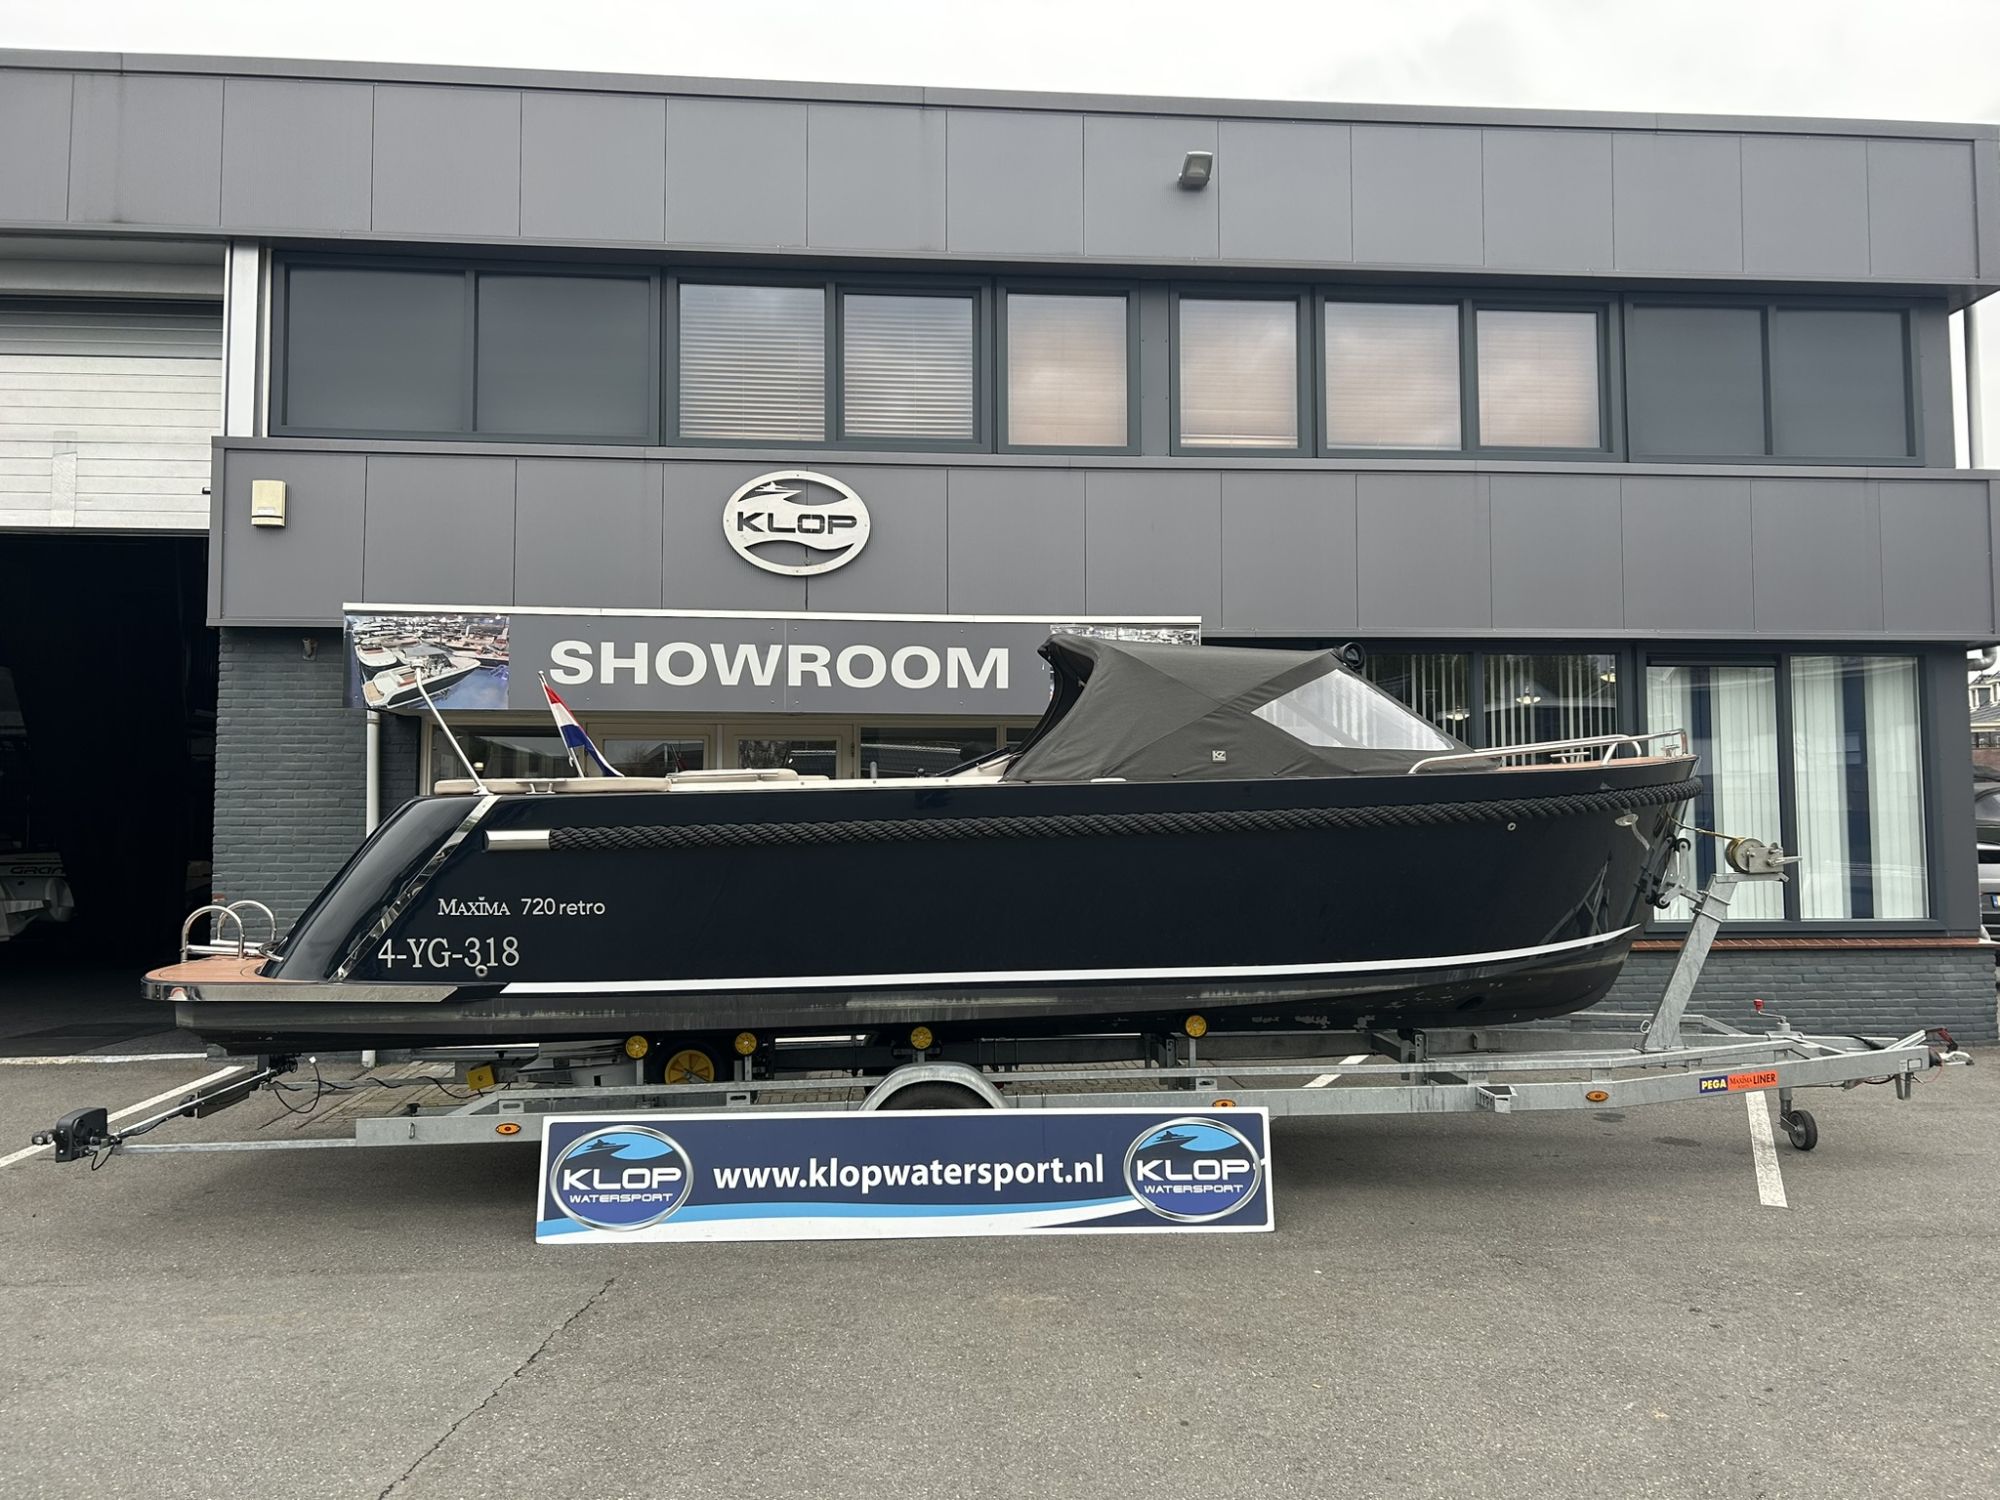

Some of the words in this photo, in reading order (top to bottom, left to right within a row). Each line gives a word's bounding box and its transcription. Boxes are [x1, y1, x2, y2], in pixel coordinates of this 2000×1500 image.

[737, 511, 858, 535] KLOP
[549, 640, 1010, 690] SHOWROOM
[438, 897, 511, 916] MAXIMA
[521, 898, 556, 916] 720
[559, 900, 606, 916] retro
[377, 936, 520, 969] 4-YG-318
[1701, 1079, 1727, 1090] PEGA
[1753, 1073, 1776, 1085] LINER
[562, 1167, 682, 1191] KLOP
[713, 1153, 1104, 1194] www.klopwatersport.nl
[1136, 1159, 1250, 1181] KLOP
[569, 1193, 673, 1204] WATERSPORT
[1144, 1184, 1244, 1194] WATERSPORT
